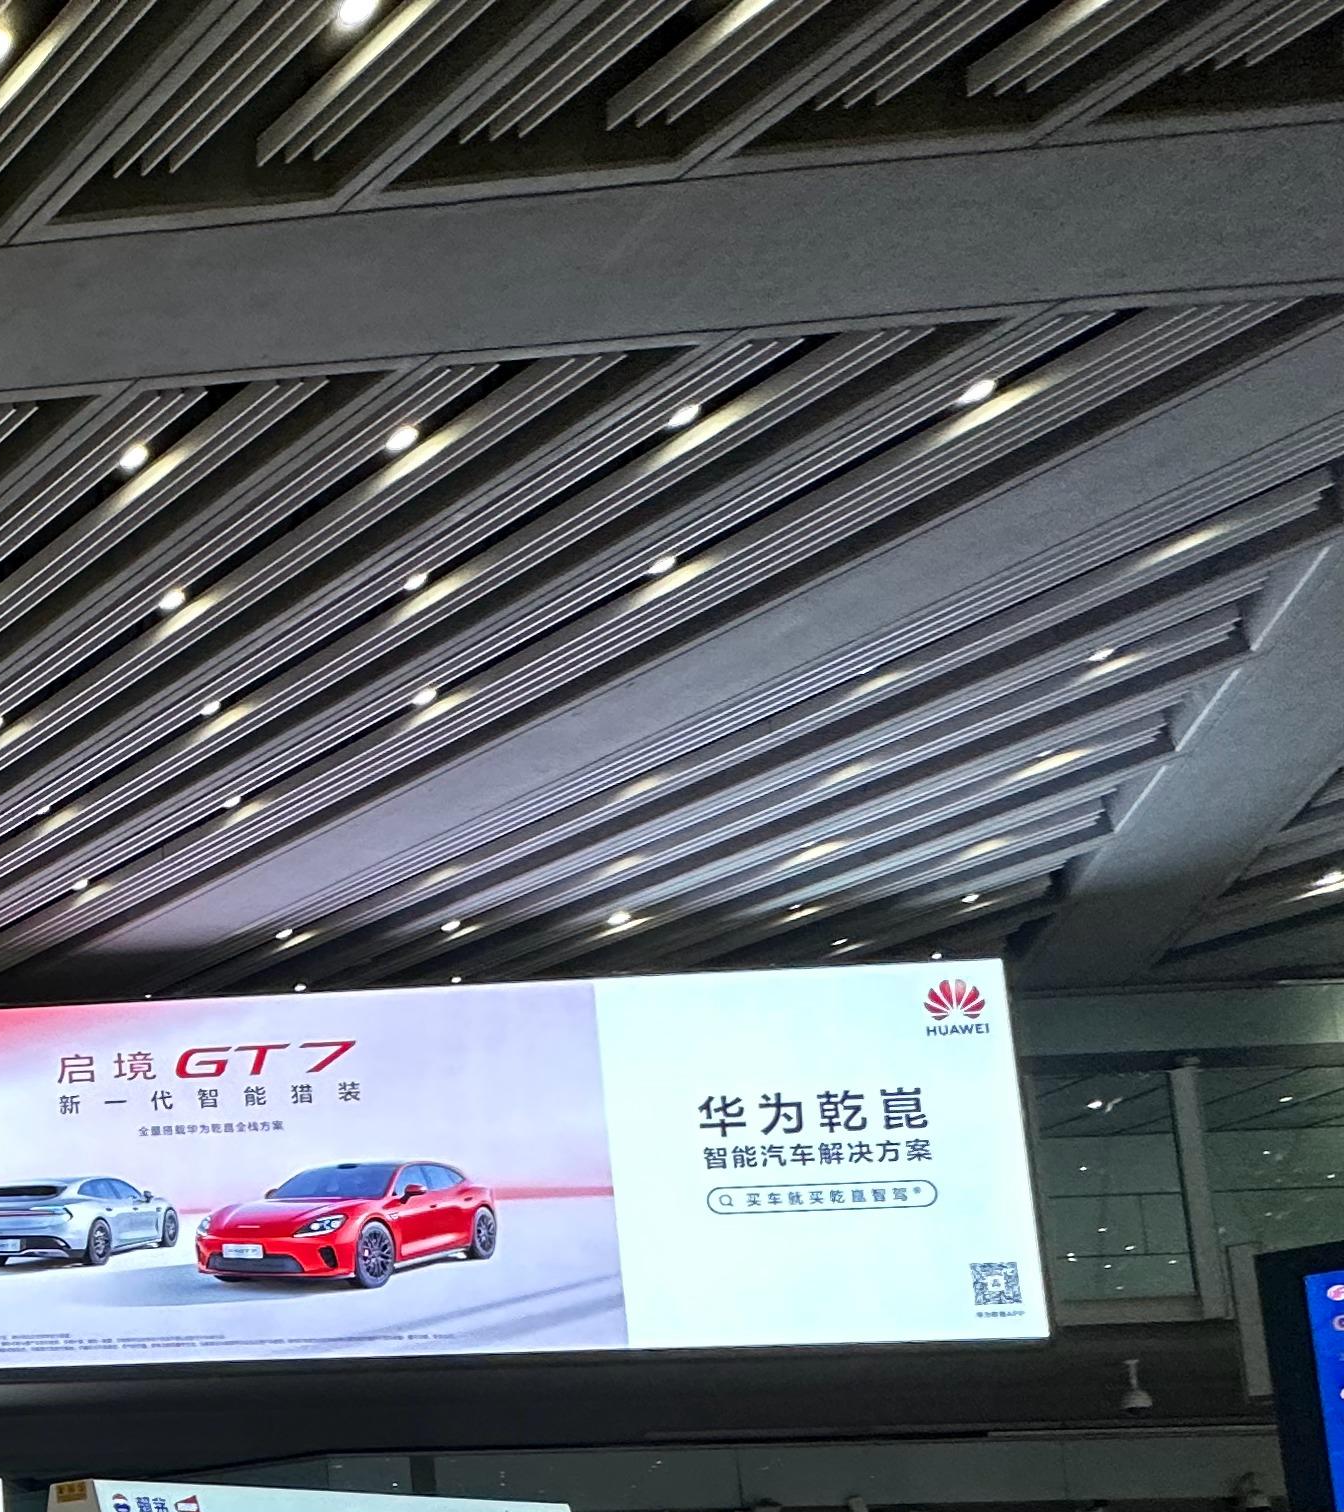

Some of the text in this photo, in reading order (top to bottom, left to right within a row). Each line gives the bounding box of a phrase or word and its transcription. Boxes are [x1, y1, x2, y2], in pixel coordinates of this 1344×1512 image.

[926, 1023, 990, 1037] HUAWEI
[57, 1053, 157, 1084] 启境
[59, 1081, 361, 1115] 新一代智能猎装
[698, 1087, 928, 1138] 华为乾崑
[703, 1138, 933, 1170] 智能汽车解决方案
